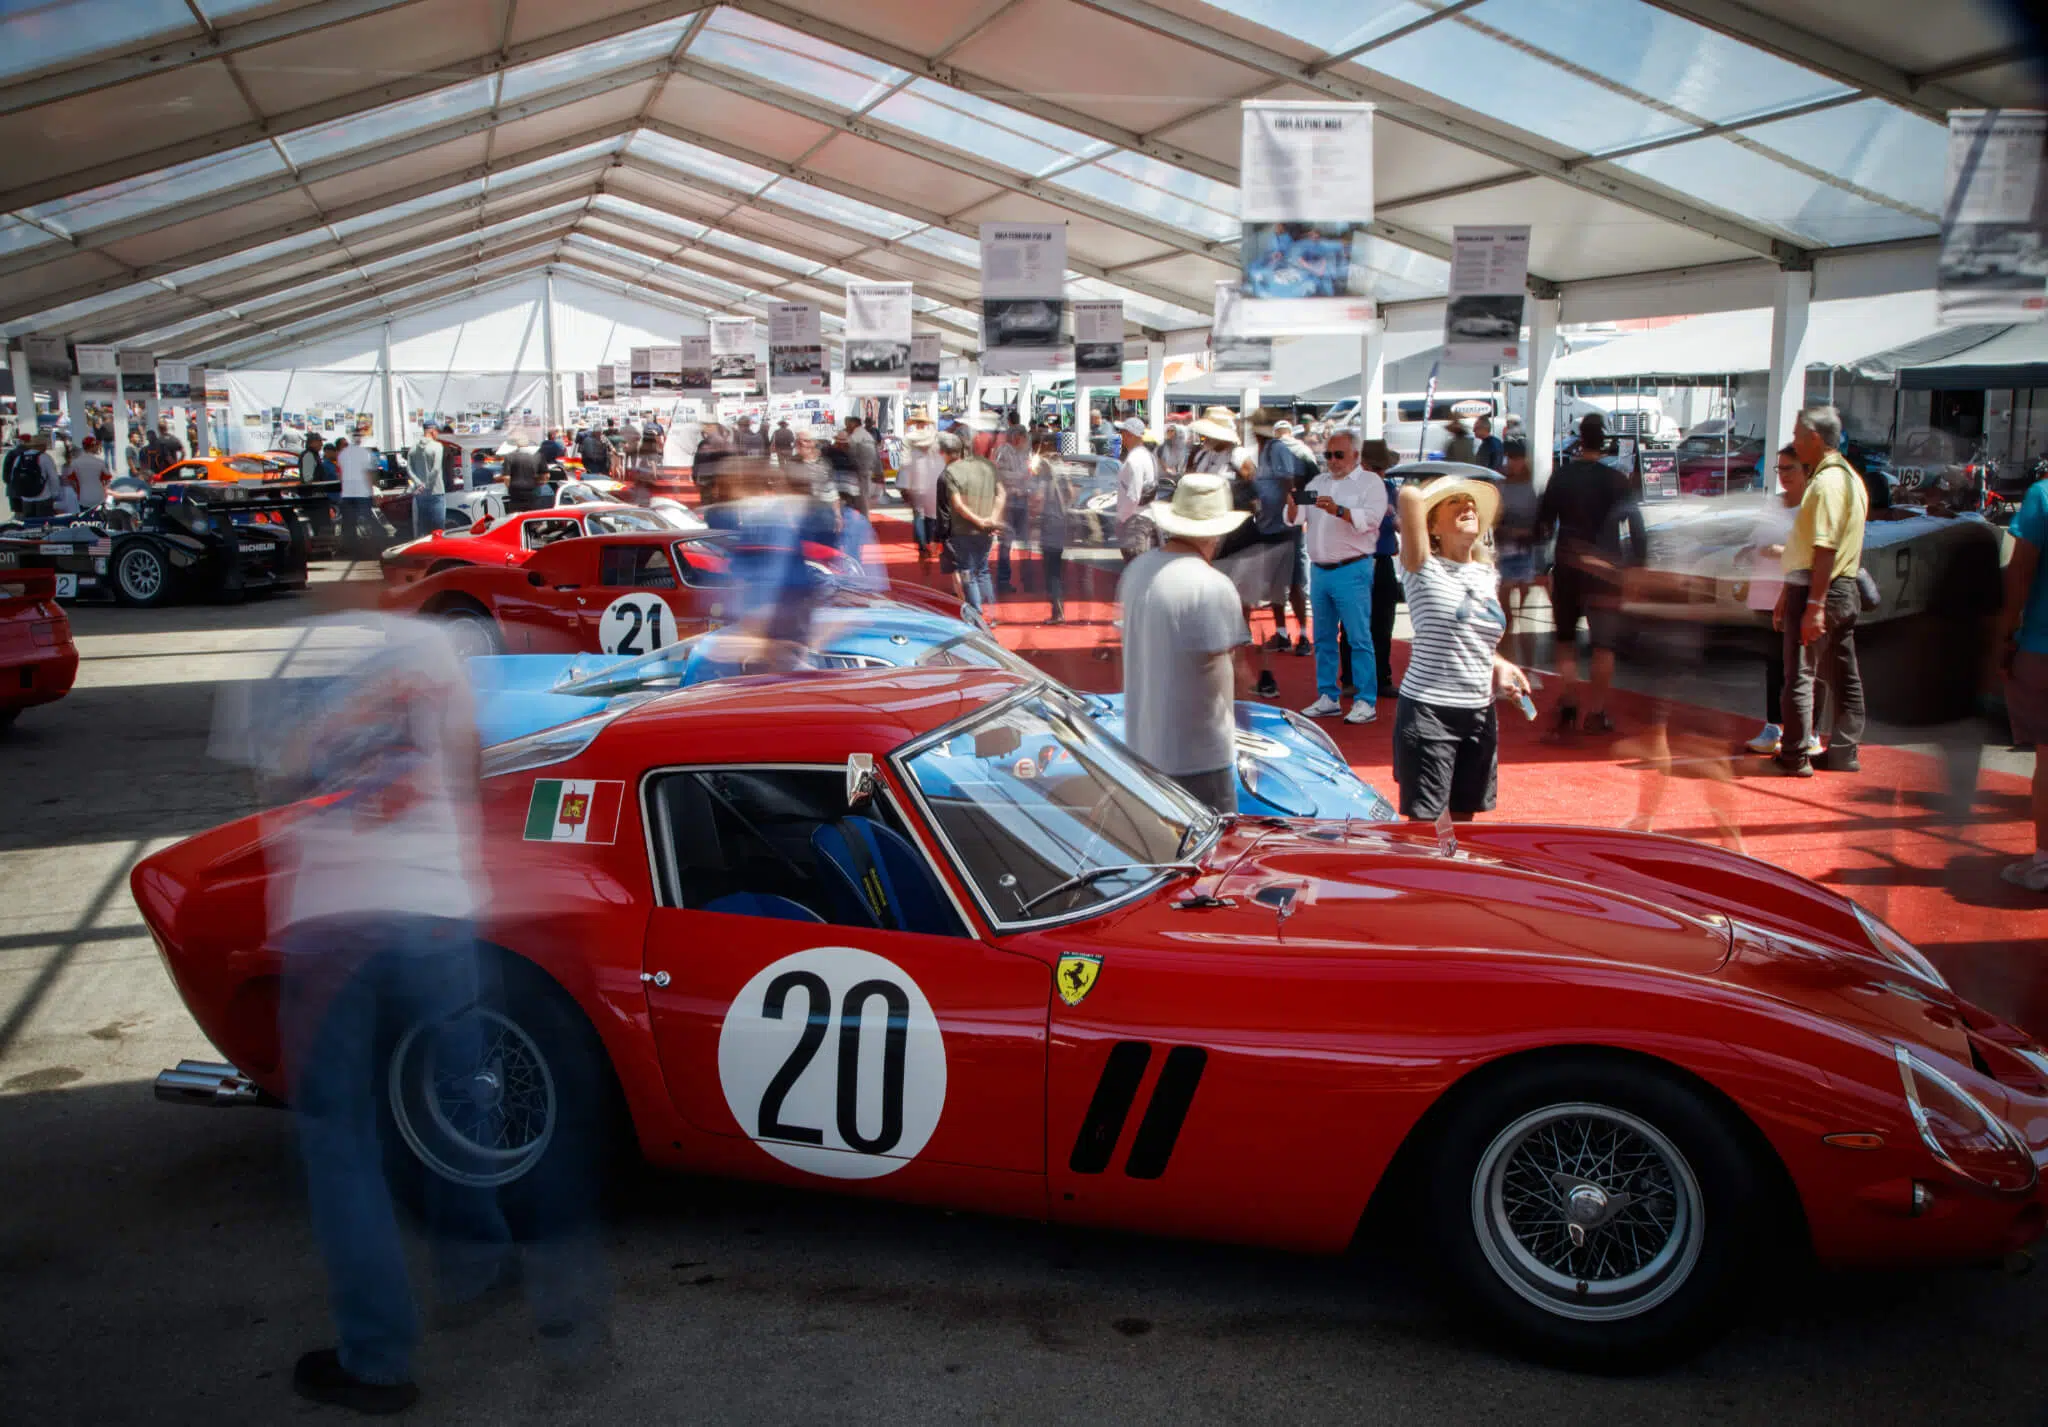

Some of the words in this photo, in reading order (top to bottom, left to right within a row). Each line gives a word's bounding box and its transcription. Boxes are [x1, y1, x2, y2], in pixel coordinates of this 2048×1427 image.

[238, 542, 276, 553] MICHELIN
[57, 576, 70, 596] 2
[615, 602, 663, 656] 21
[757, 969, 911, 1156] 20
